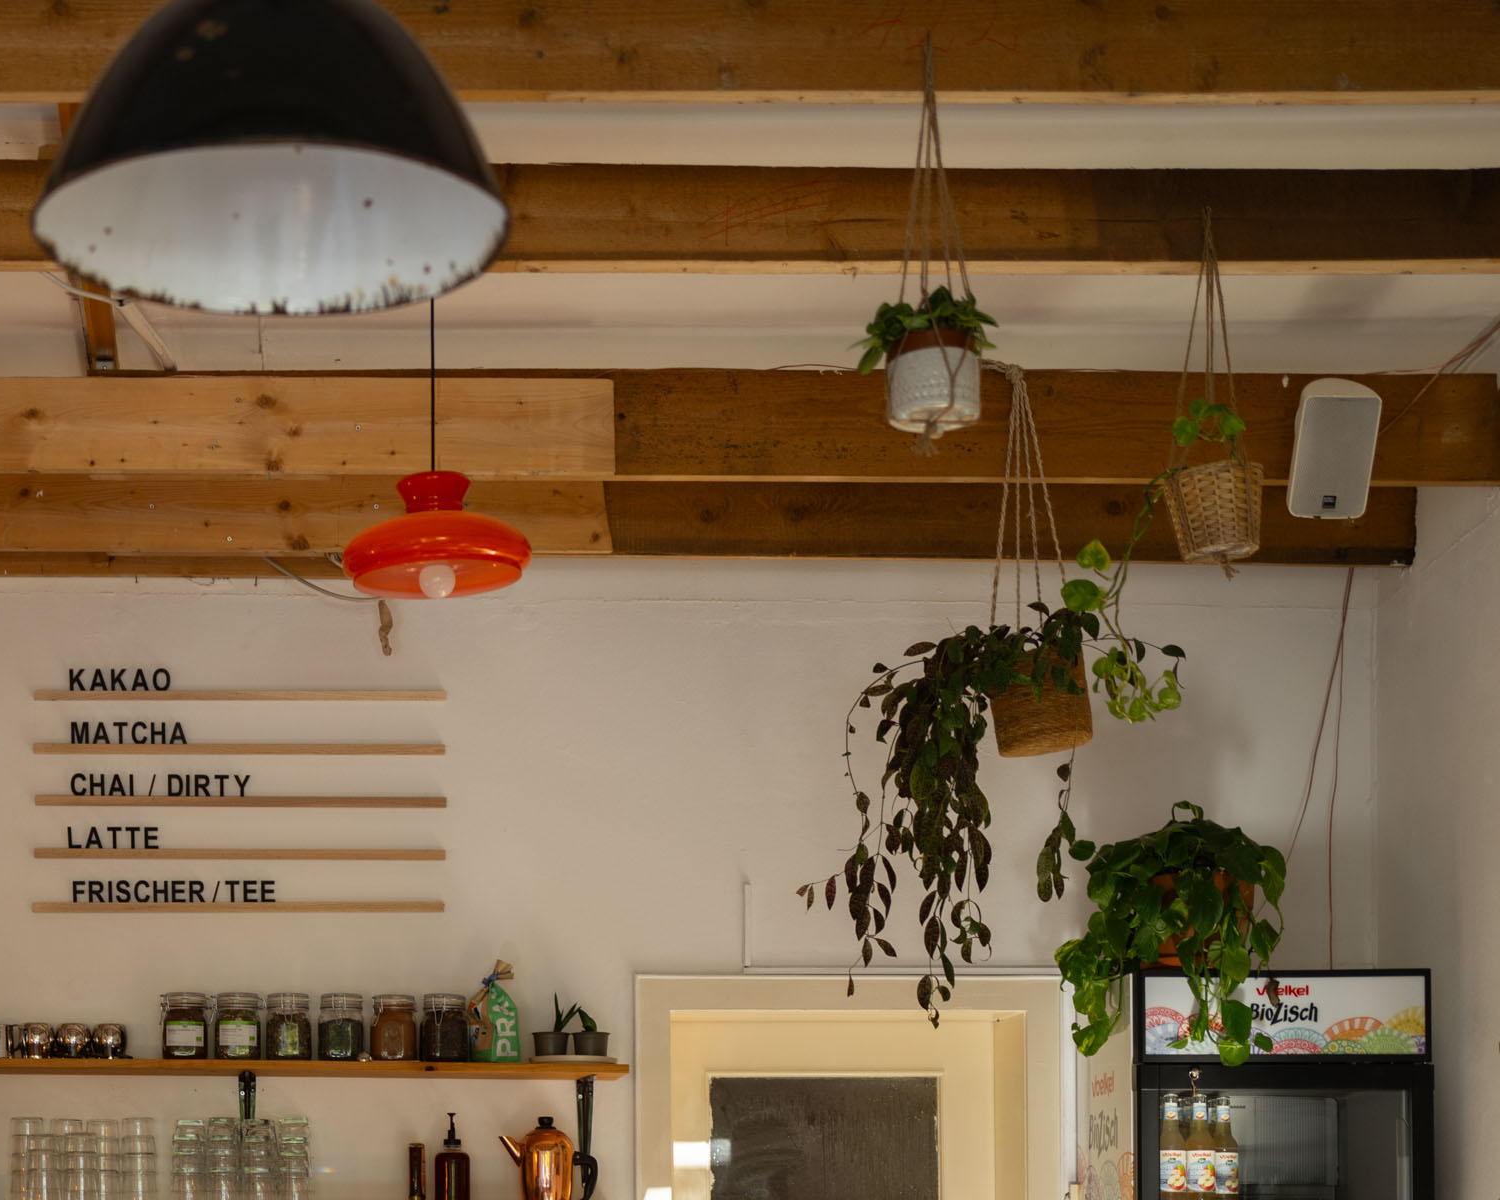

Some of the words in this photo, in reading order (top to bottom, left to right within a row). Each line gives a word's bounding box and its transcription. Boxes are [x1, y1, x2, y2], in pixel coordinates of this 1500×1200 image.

[68, 668, 171, 691] KAKAO
[70, 721, 187, 744] MATCHA
[70, 773, 135, 797] CHAI
[167, 774, 250, 797] DIRTY
[67, 826, 159, 849] LATTE
[72, 880, 205, 903] FRISCHER
[1256, 984, 1309, 997] velkel
[1251, 1002, 1318, 1025] BioZisch
